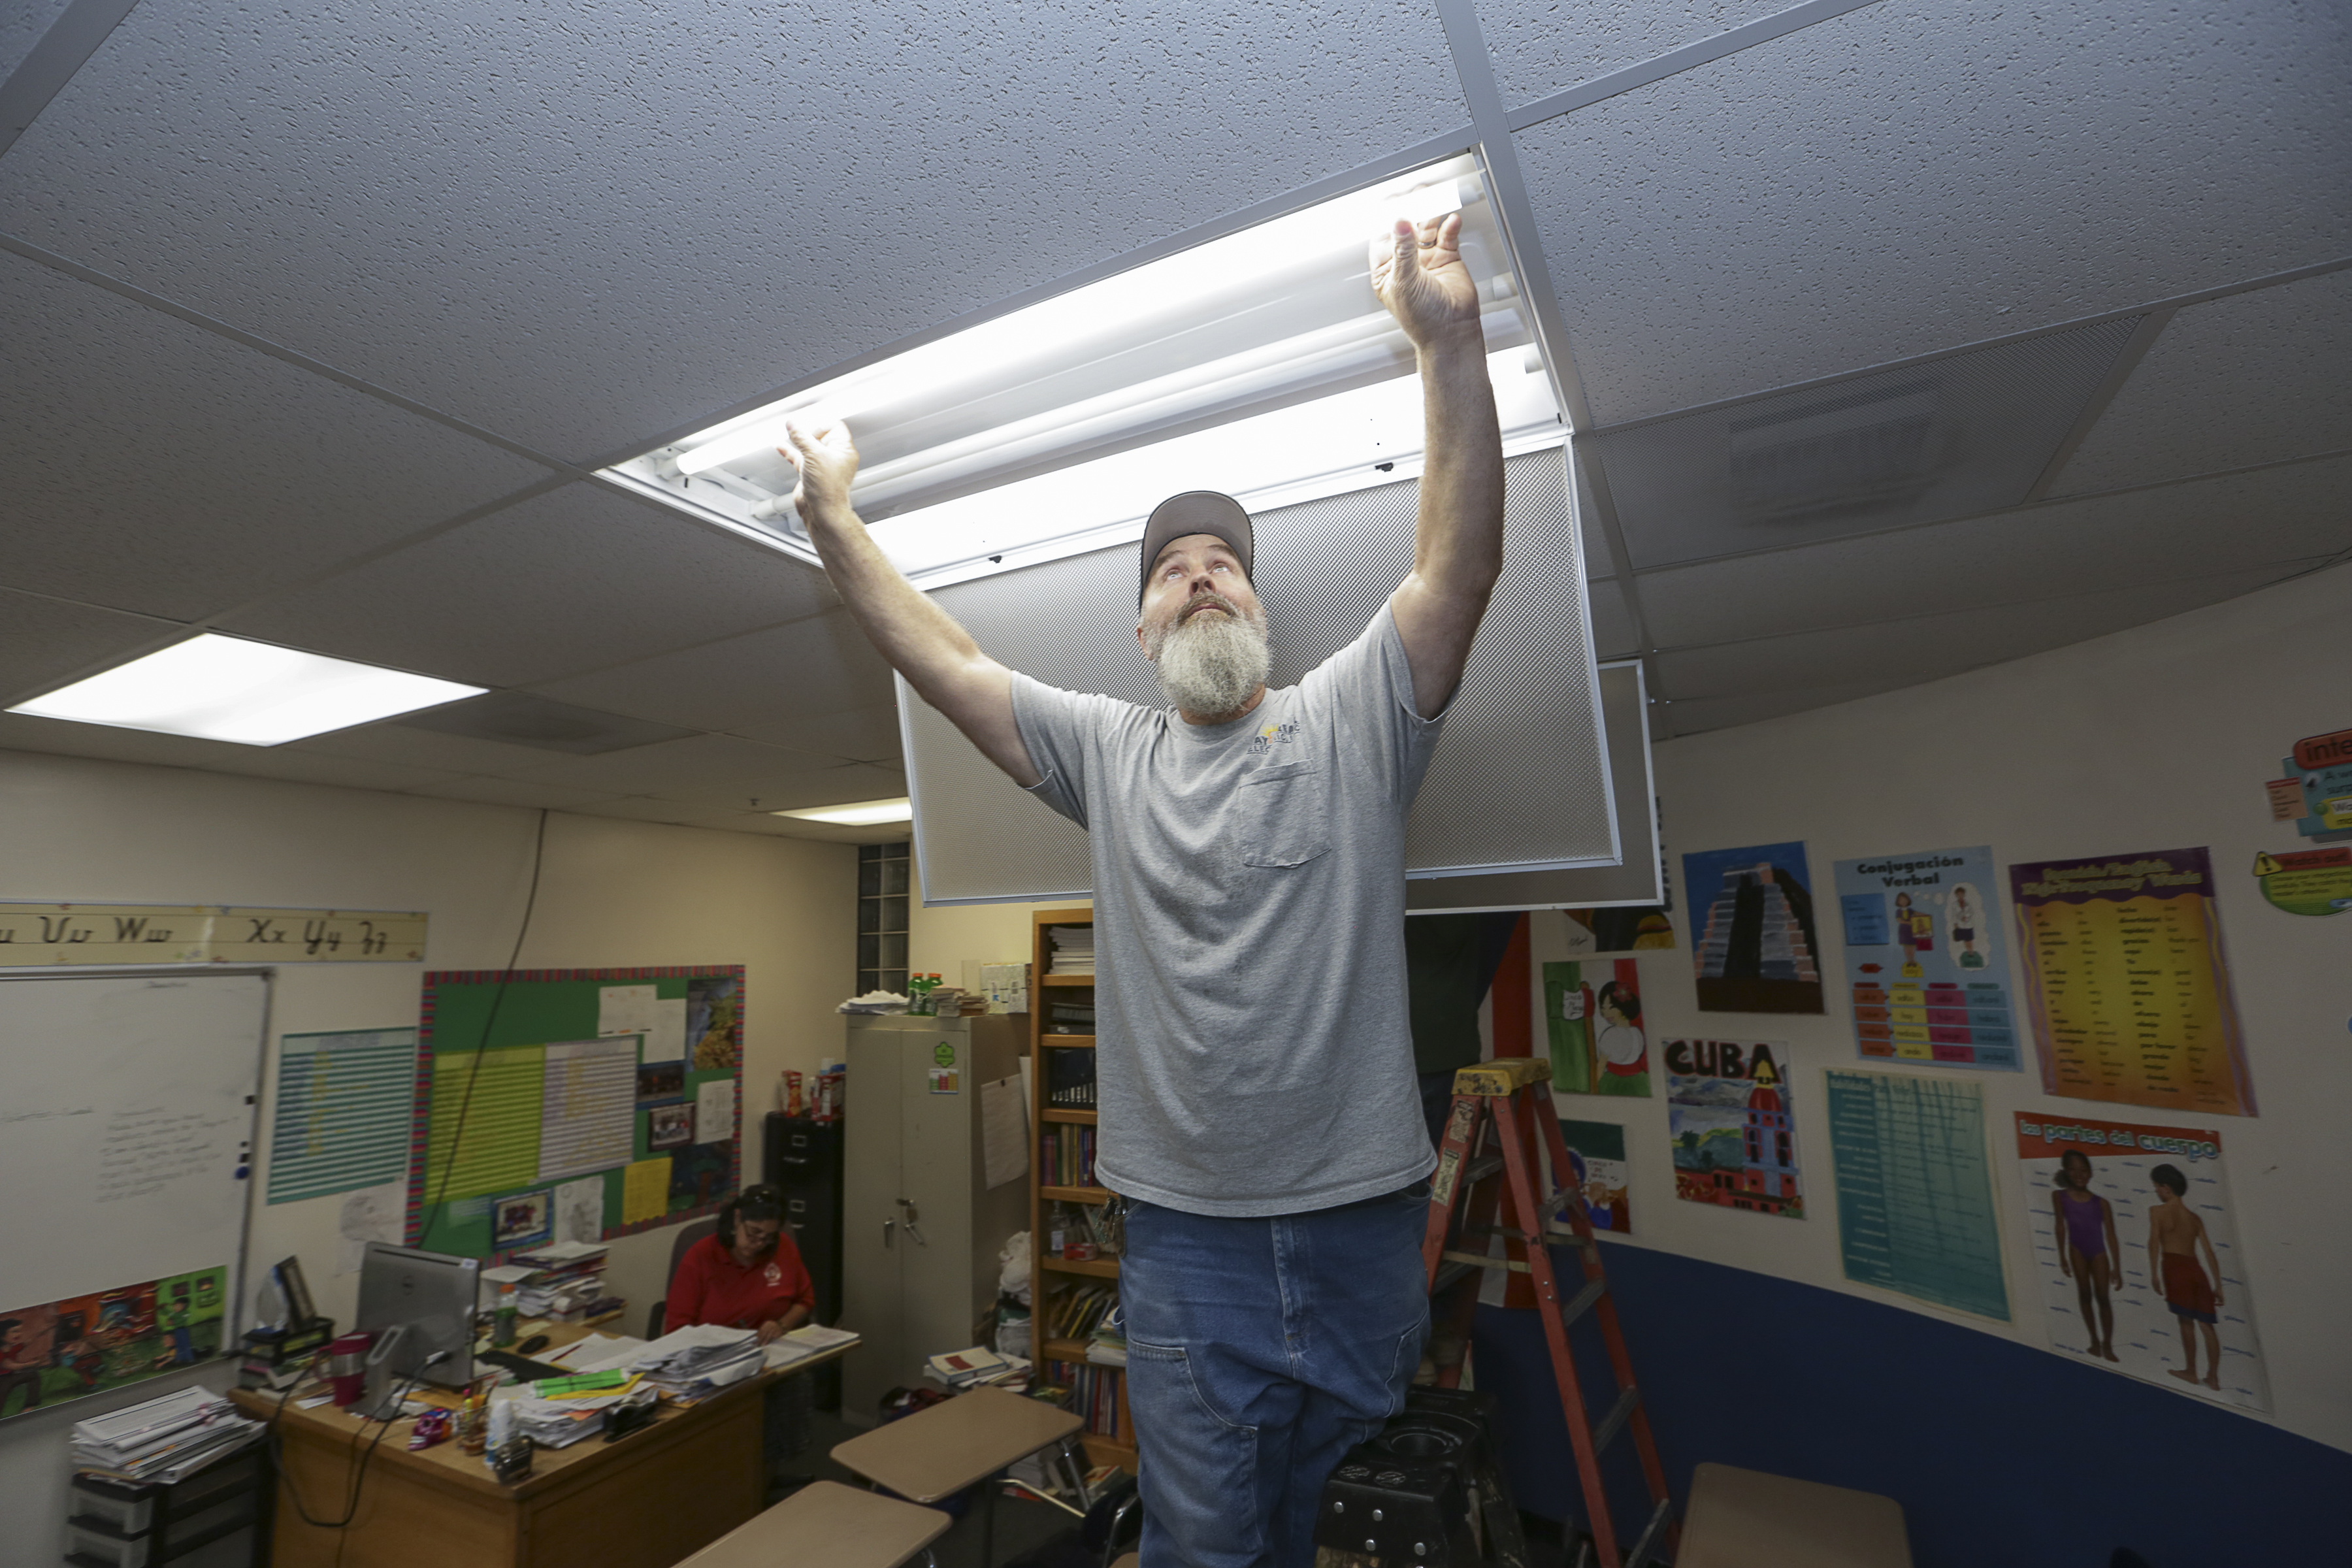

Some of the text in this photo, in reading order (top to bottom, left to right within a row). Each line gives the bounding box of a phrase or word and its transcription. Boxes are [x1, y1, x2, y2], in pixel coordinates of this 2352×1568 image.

[1857, 855, 1965, 875] Conjugación
[1882, 872, 1940, 888] Verbal
[114, 917, 173, 943] Ww
[246, 919, 287, 943] Xx
[304, 920, 342, 955] Yy
[1664, 1039, 1782, 1084] CUBA
[2019, 1119, 2218, 1162] las partes del cuerpo
